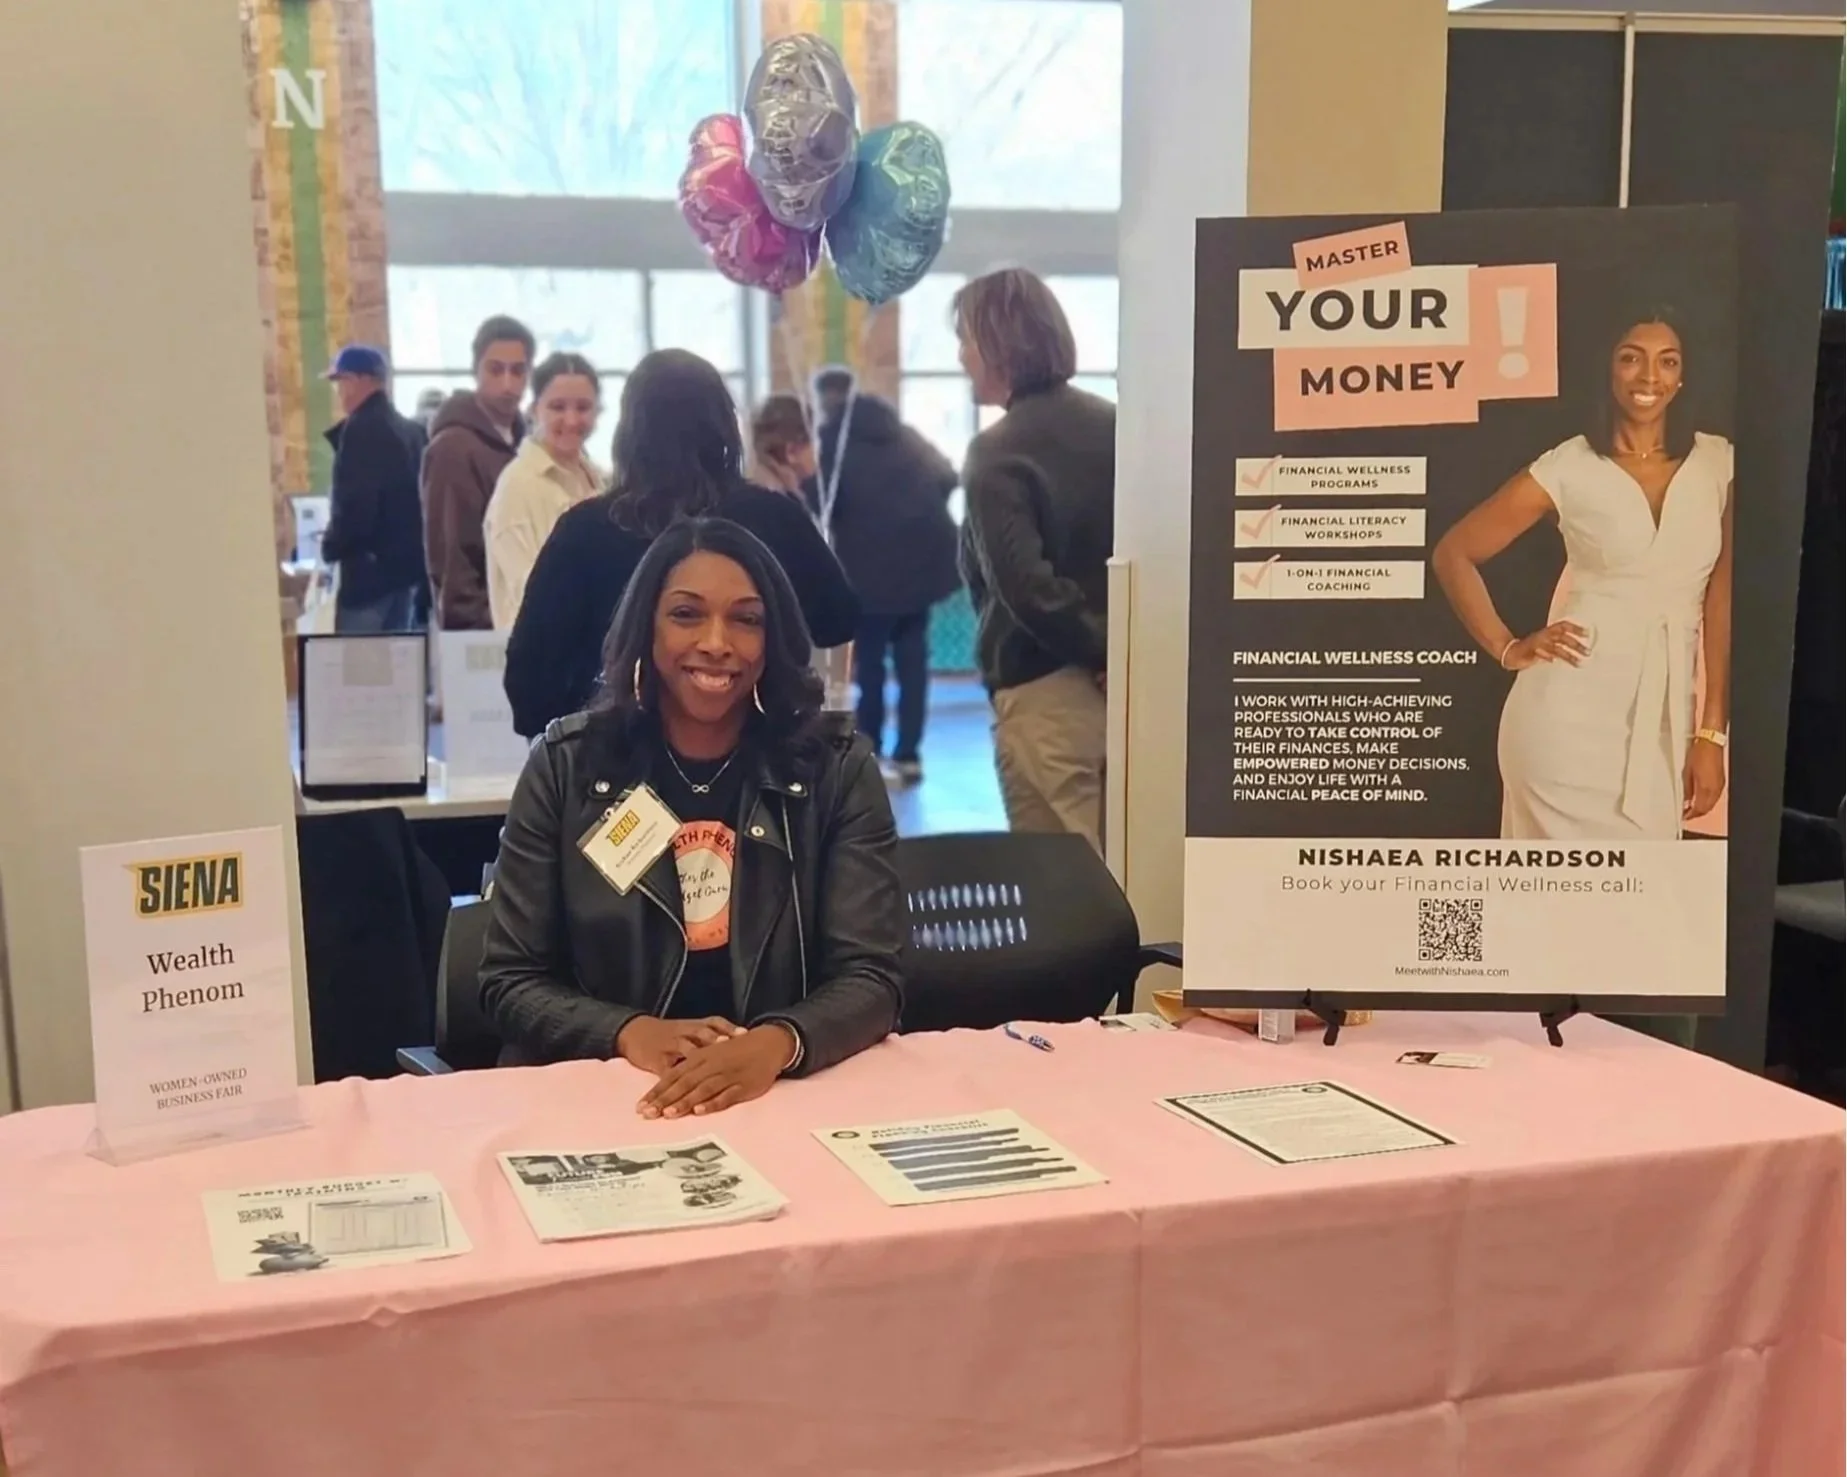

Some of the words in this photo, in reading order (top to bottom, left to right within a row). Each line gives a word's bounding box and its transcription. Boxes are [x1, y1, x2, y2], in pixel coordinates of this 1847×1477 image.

[269, 68, 327, 130] N
[1306, 239, 1400, 272] MASTER
[1265, 288, 1448, 331] YOUR
[1300, 360, 1465, 396] MONEY
[1279, 466, 1342, 475] FINANCIAL
[1347, 465, 1411, 474] WELLNESS
[1311, 479, 1378, 489] PROGRAMS
[1281, 517, 1345, 526] FINANCIAL
[1350, 516, 1406, 525] LITERACY
[1305, 530, 1382, 539] WORKSHOPS
[1287, 569, 1322, 577] 1-ON-1
[1327, 568, 1391, 577] FINANCIAL
[1307, 582, 1371, 591] COACHING
[1233, 652, 1321, 665] FINANCIAL
[1324, 651, 1414, 665] WELLNESS
[1416, 651, 1478, 664] COACH
[1234, 696, 1239, 707] I
[1242, 696, 1287, 707] WORK
[1290, 696, 1328, 707] WITH
[1332, 696, 1452, 707] HIGH-ACHIEVING
[1234, 711, 1350, 723] PROFESSIONALS
[1353, 711, 1391, 723] WHO
[1394, 711, 1424, 723] ARE
[1234, 727, 1282, 738] READY
[1286, 727, 1305, 738] TO
[1308, 727, 1347, 738] TAKE
[1350, 727, 1420, 738] CONTROL
[1423, 727, 1443, 738] OF
[1234, 743, 1275, 754] THEIR
[1279, 743, 1353, 756] FINANCES,
[1356, 743, 1399, 754] MAKE
[1233, 758, 1330, 770] EMPOWERED
[1332, 758, 1386, 770] MONEY
[1389, 758, 1470, 772] DECISIONS,
[1233, 774, 1265, 785] AND
[1268, 774, 1314, 785] ENJOY
[1318, 774, 1347, 785] LIFE
[1350, 774, 1387, 785] WITH
[1391, 774, 1402, 785] A
[1233, 790, 1308, 801] FINANCIAL
[1311, 790, 1359, 801] PEACE
[1362, 790, 1383, 801] OF
[1385, 790, 1428, 801] MIND.
[1298, 848, 1424, 867] NISHAEA
[1435, 849, 1627, 868] RICHARDSON
[138, 856, 240, 915] SIENA
[1281, 876, 1333, 891] Book
[1339, 878, 1385, 894] your
[1395, 876, 1490, 892] Financial
[1498, 877, 1593, 893] Wellness
[1601, 877, 1644, 893] call:
[147, 942, 235, 975] Wealth
[1395, 966, 1509, 977] MeetwithNishaea.com
[141, 981, 245, 1014] Phenom
[149, 1067, 248, 1095] WOMEN-OWNED
[156, 1091, 214, 1110] BUSINESS
[215, 1085, 243, 1099] FAIR
